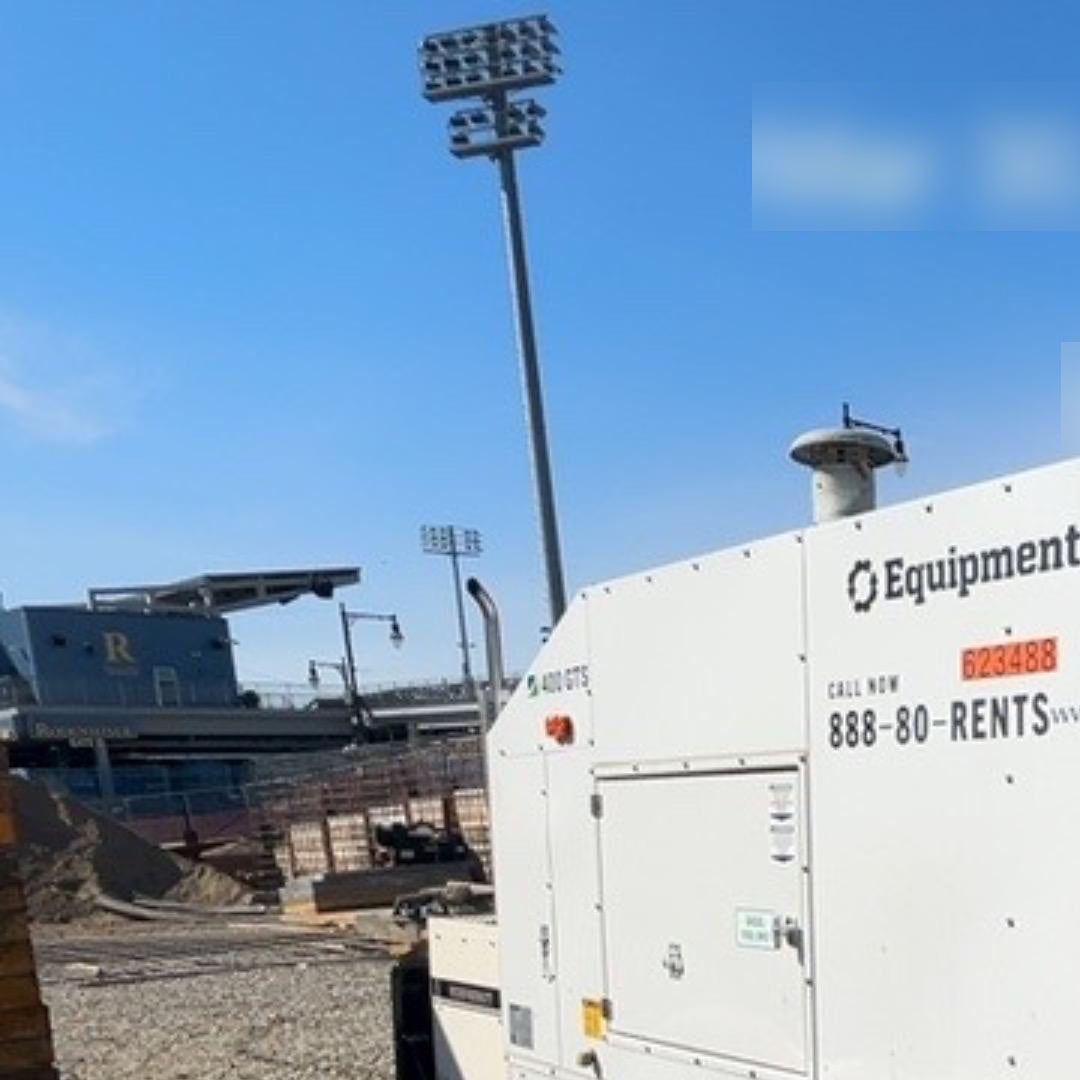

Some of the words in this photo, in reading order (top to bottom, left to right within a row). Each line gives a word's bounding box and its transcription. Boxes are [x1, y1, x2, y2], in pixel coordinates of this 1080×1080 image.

[101, 631, 137, 664] R
[963, 639, 1056, 680] 623488
[828, 680, 862, 700] CALL
[867, 675, 899, 695] NOW
[829, 692, 1050, 749] 888-80-RENTS
